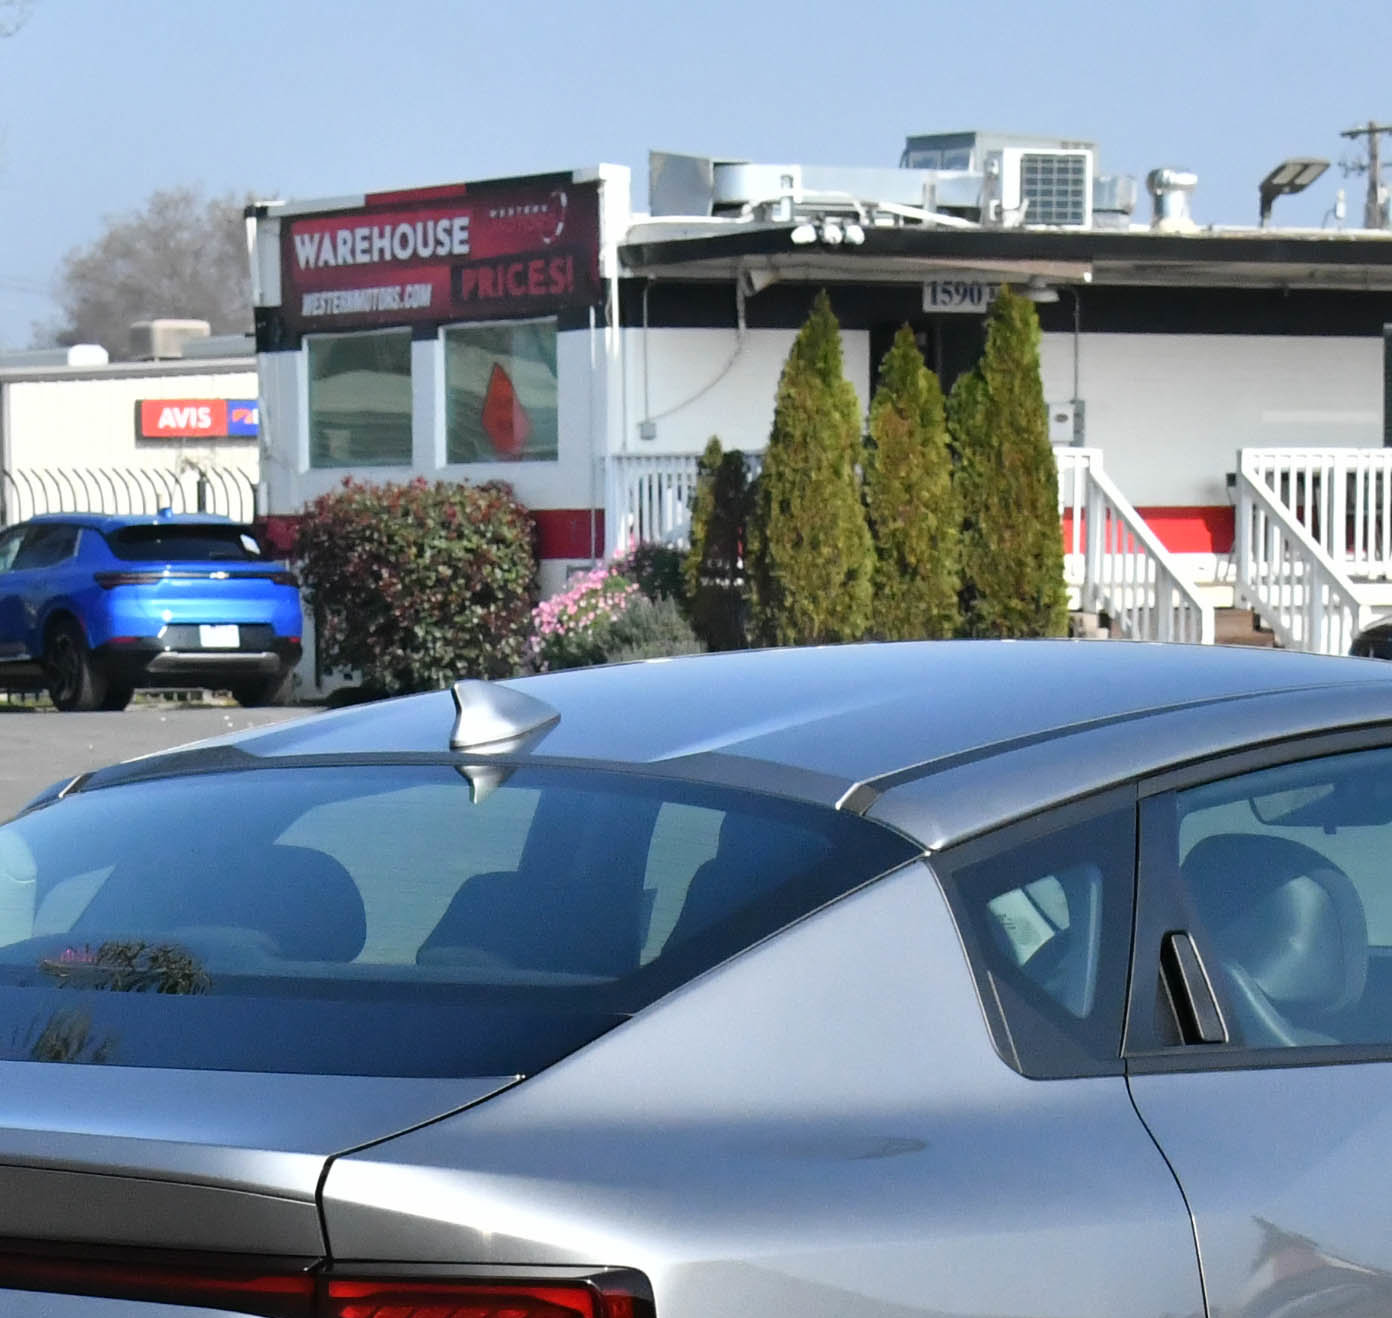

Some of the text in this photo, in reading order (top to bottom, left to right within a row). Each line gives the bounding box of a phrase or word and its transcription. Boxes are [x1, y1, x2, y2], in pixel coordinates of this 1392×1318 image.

[293, 217, 470, 271] WAREHOUSE
[462, 255, 575, 302] PRICES!
[928, 281, 983, 306] 1590
[157, 406, 212, 429] AVIS
